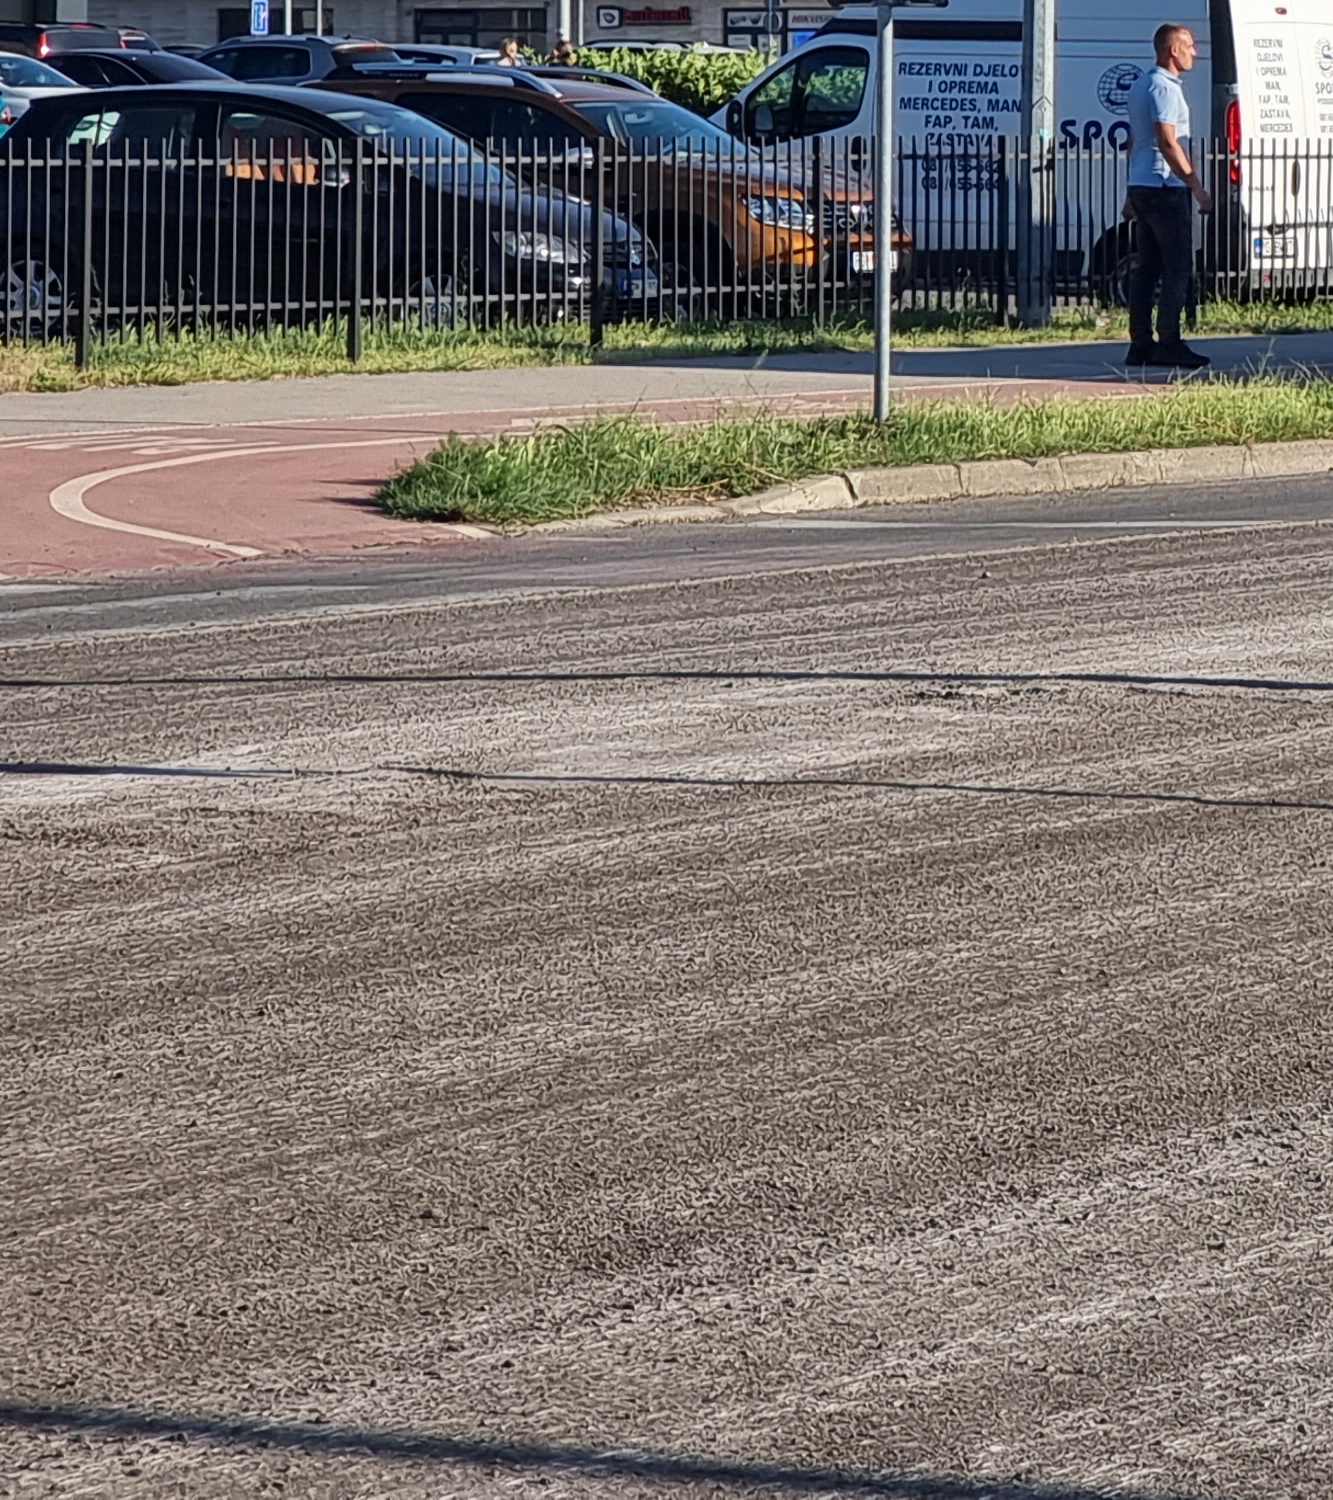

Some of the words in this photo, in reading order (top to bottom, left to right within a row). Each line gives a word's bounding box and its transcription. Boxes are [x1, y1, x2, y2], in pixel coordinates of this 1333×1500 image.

[898, 62, 968, 77] REZERVNI
[972, 63, 1023, 78] DJELO
[927, 79, 933, 93] I
[937, 80, 1000, 95] OPREMA
[899, 97, 982, 114] MERCEDES,
[924, 114, 957, 131] FAP,
[961, 115, 998, 132] TAM,
